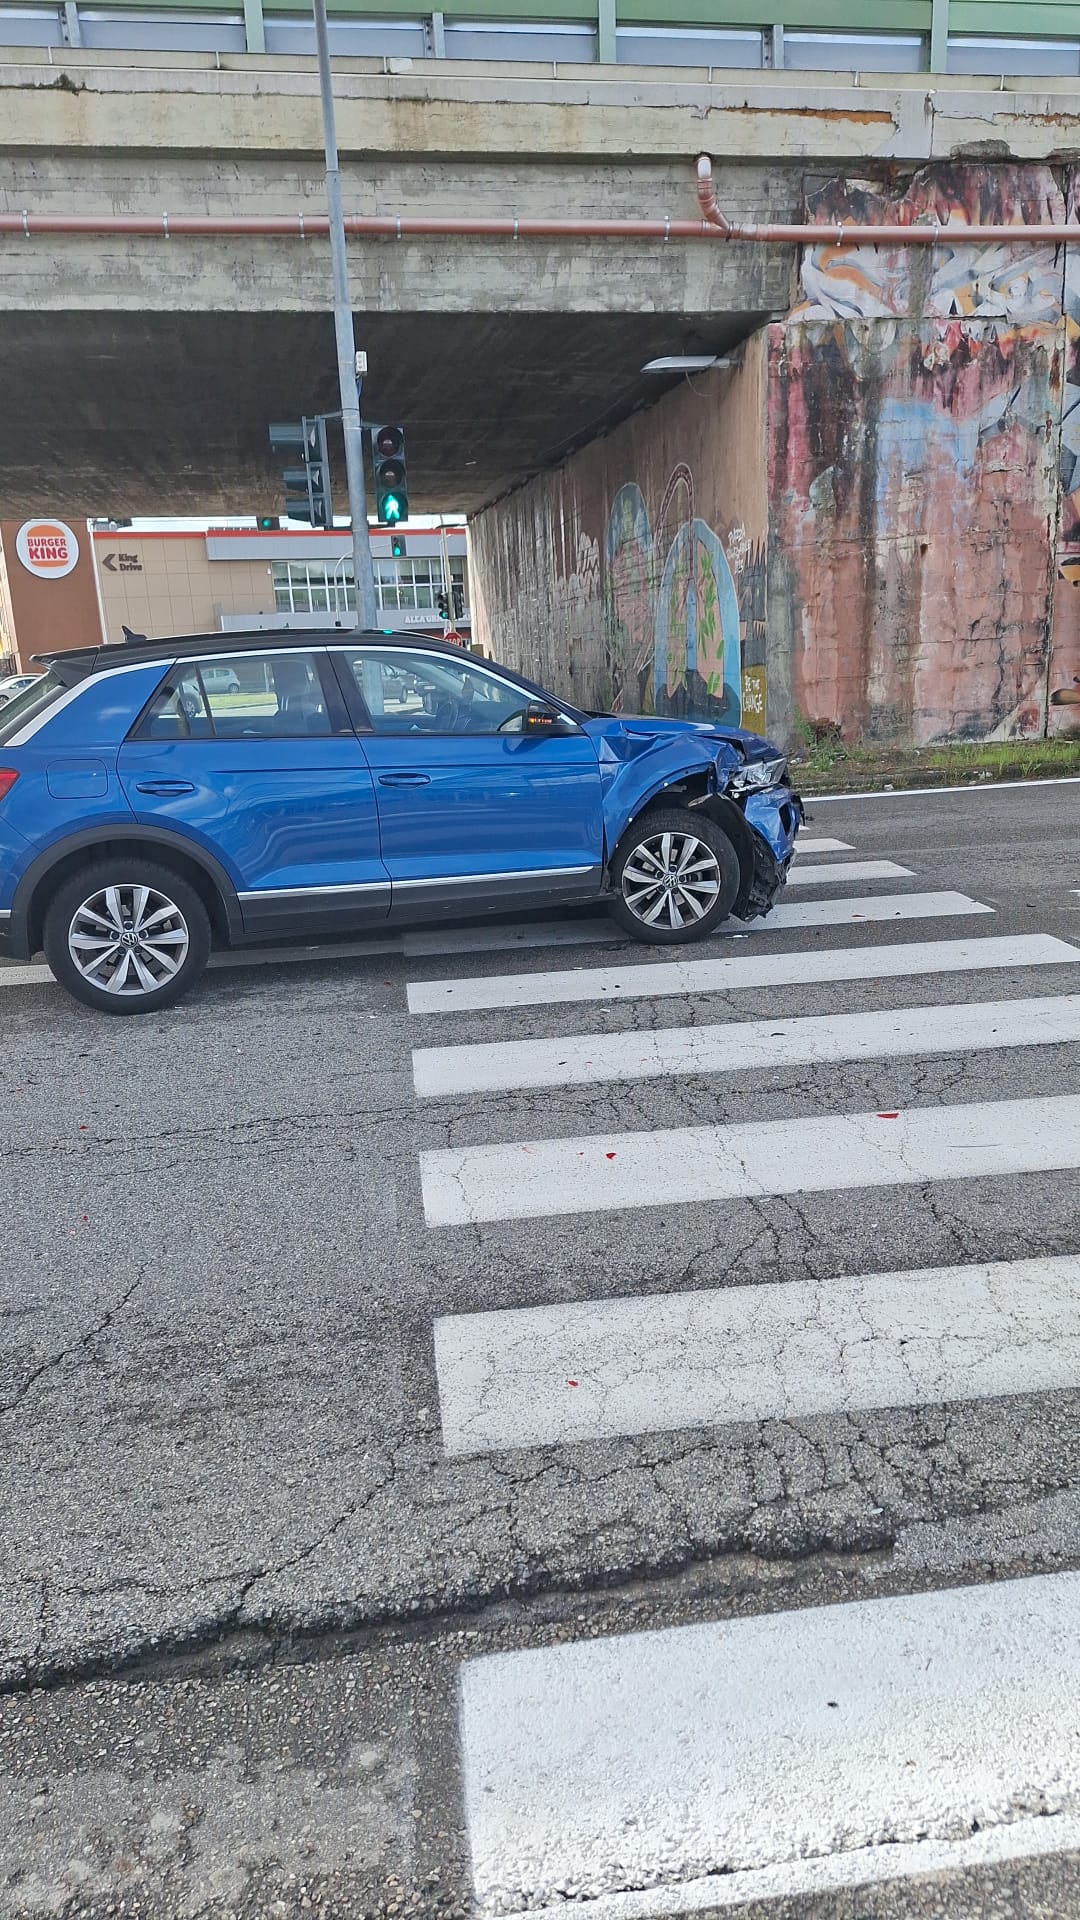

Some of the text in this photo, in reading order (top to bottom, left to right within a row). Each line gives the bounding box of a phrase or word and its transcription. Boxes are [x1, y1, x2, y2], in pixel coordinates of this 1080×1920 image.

[27, 538, 67, 547] BURGER
[29, 547, 68, 559] KING
[119, 554, 139, 563] King
[120, 563, 143, 571] Drive
